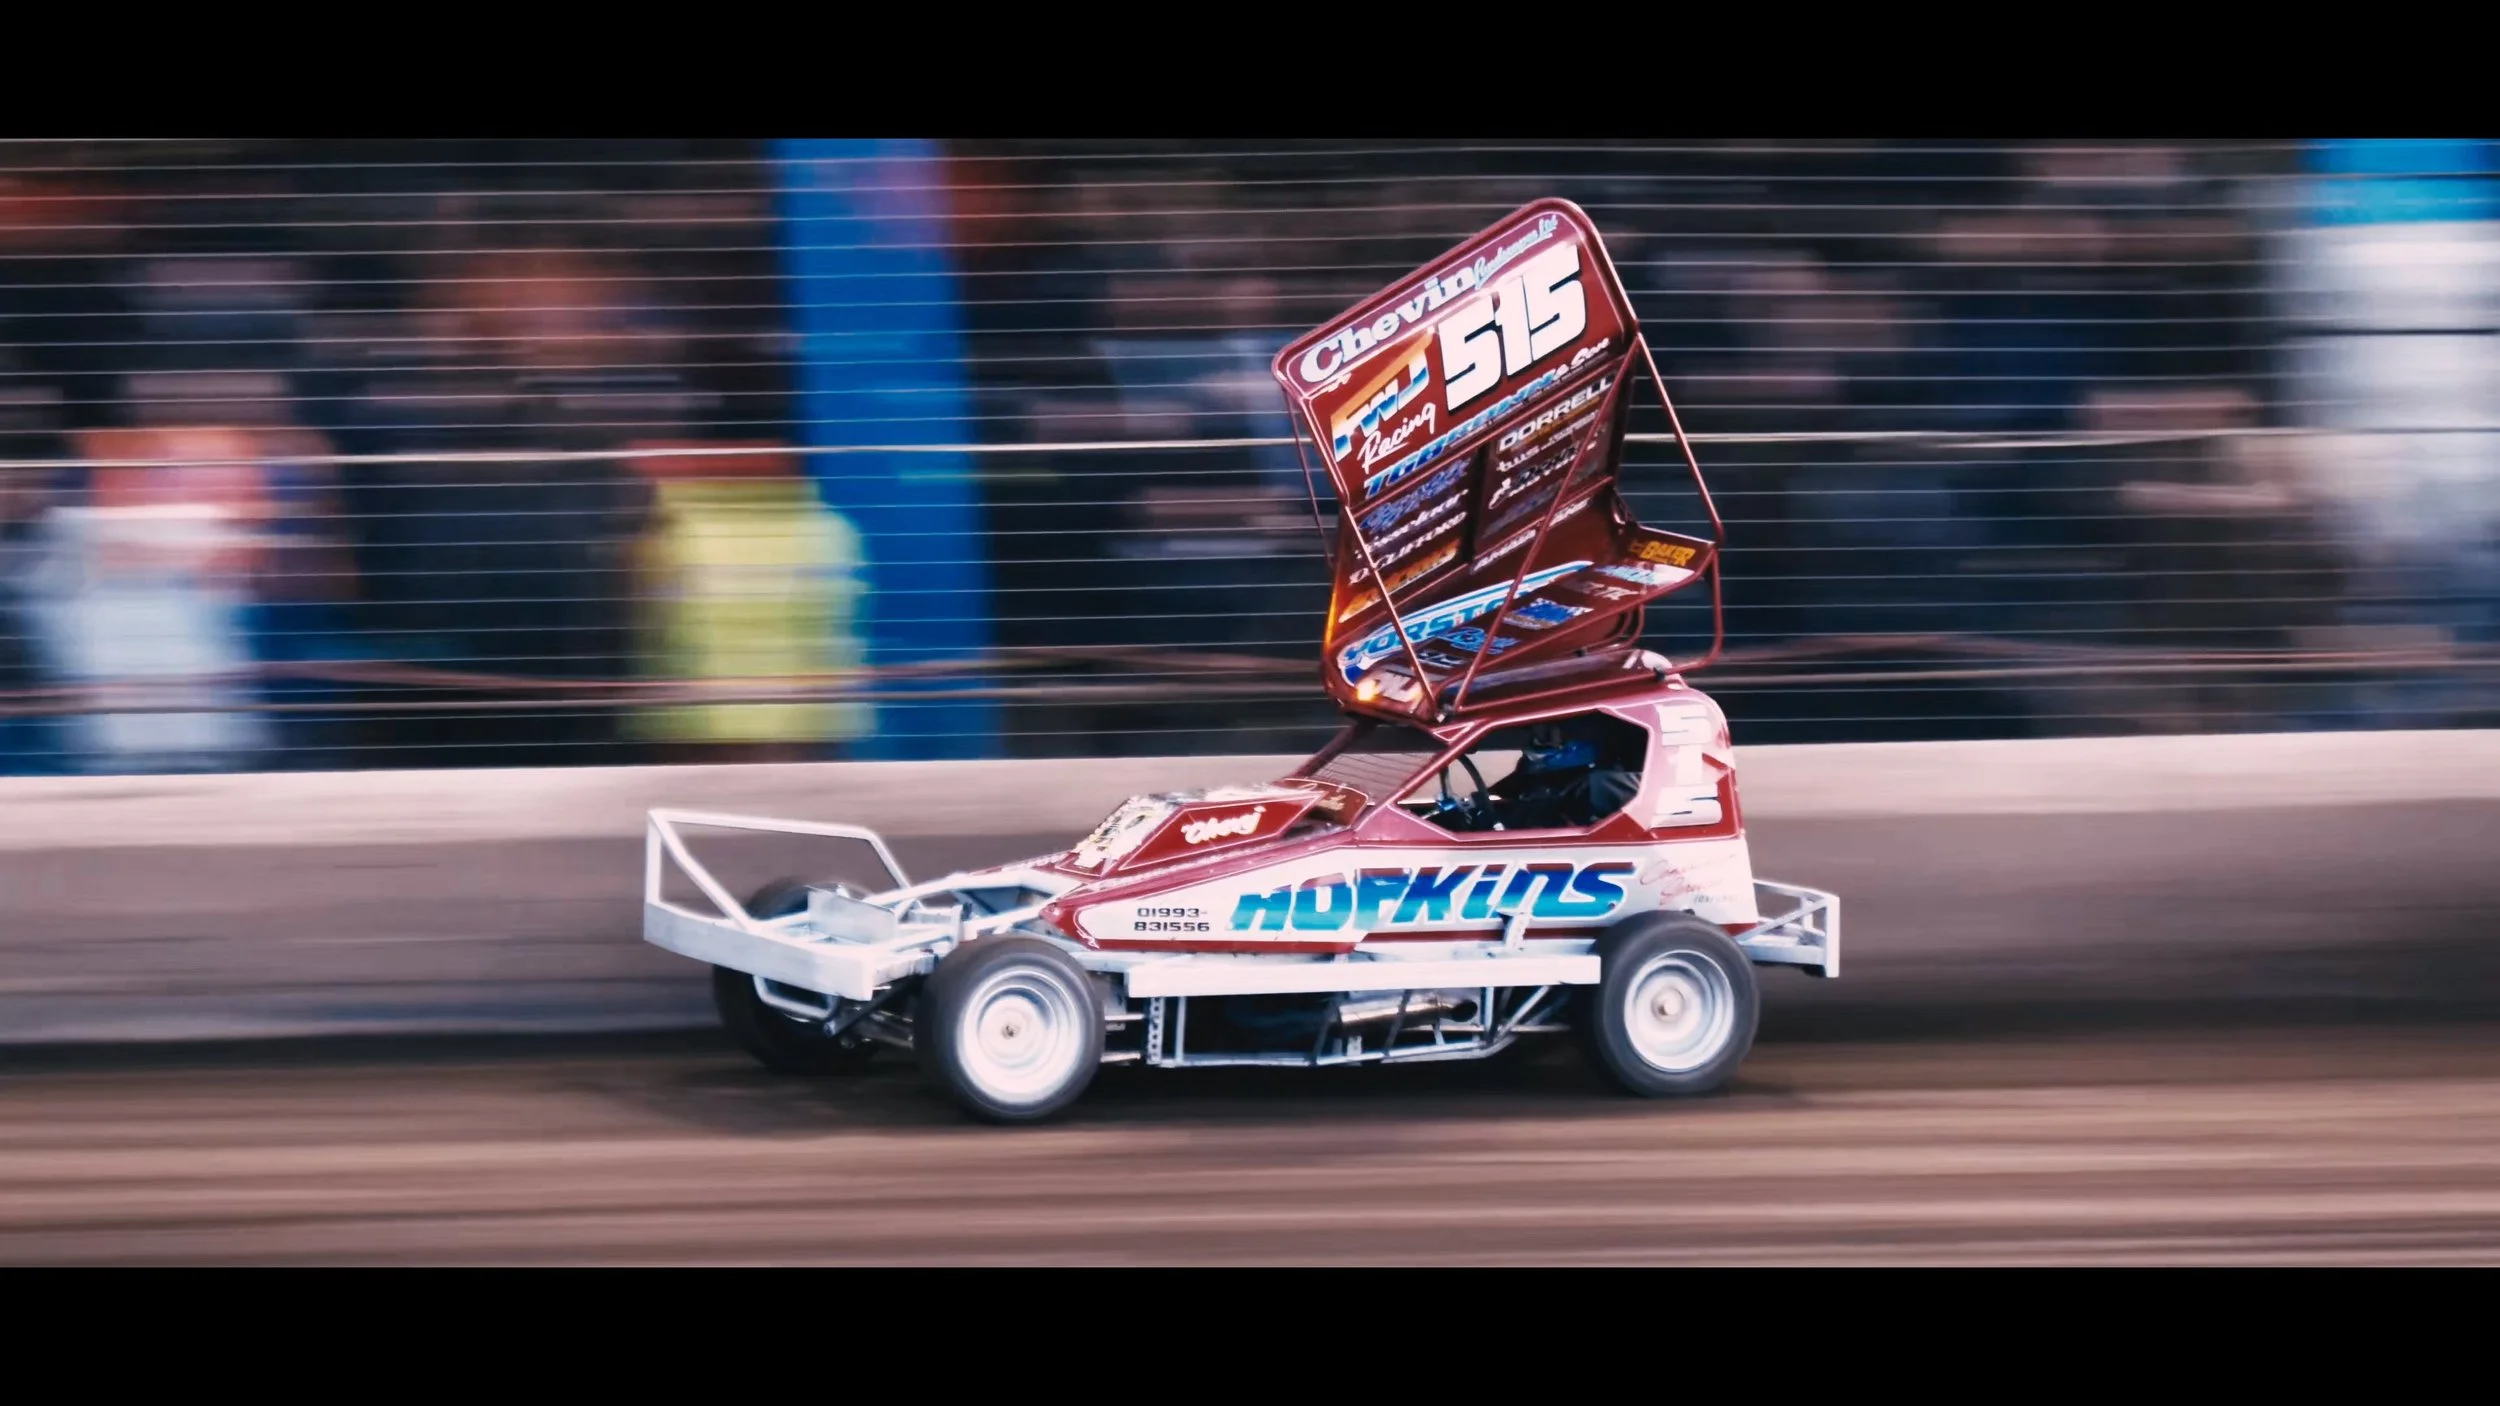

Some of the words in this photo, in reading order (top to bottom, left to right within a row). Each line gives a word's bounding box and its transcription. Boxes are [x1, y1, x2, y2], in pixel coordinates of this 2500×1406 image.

[1300, 264, 1476, 383] Chevin
[1438, 240, 1586, 412] 515
[1357, 402, 1436, 475] Racing
[1499, 375, 1614, 452] DORRELL
[1134, 921, 1210, 932] 831556
